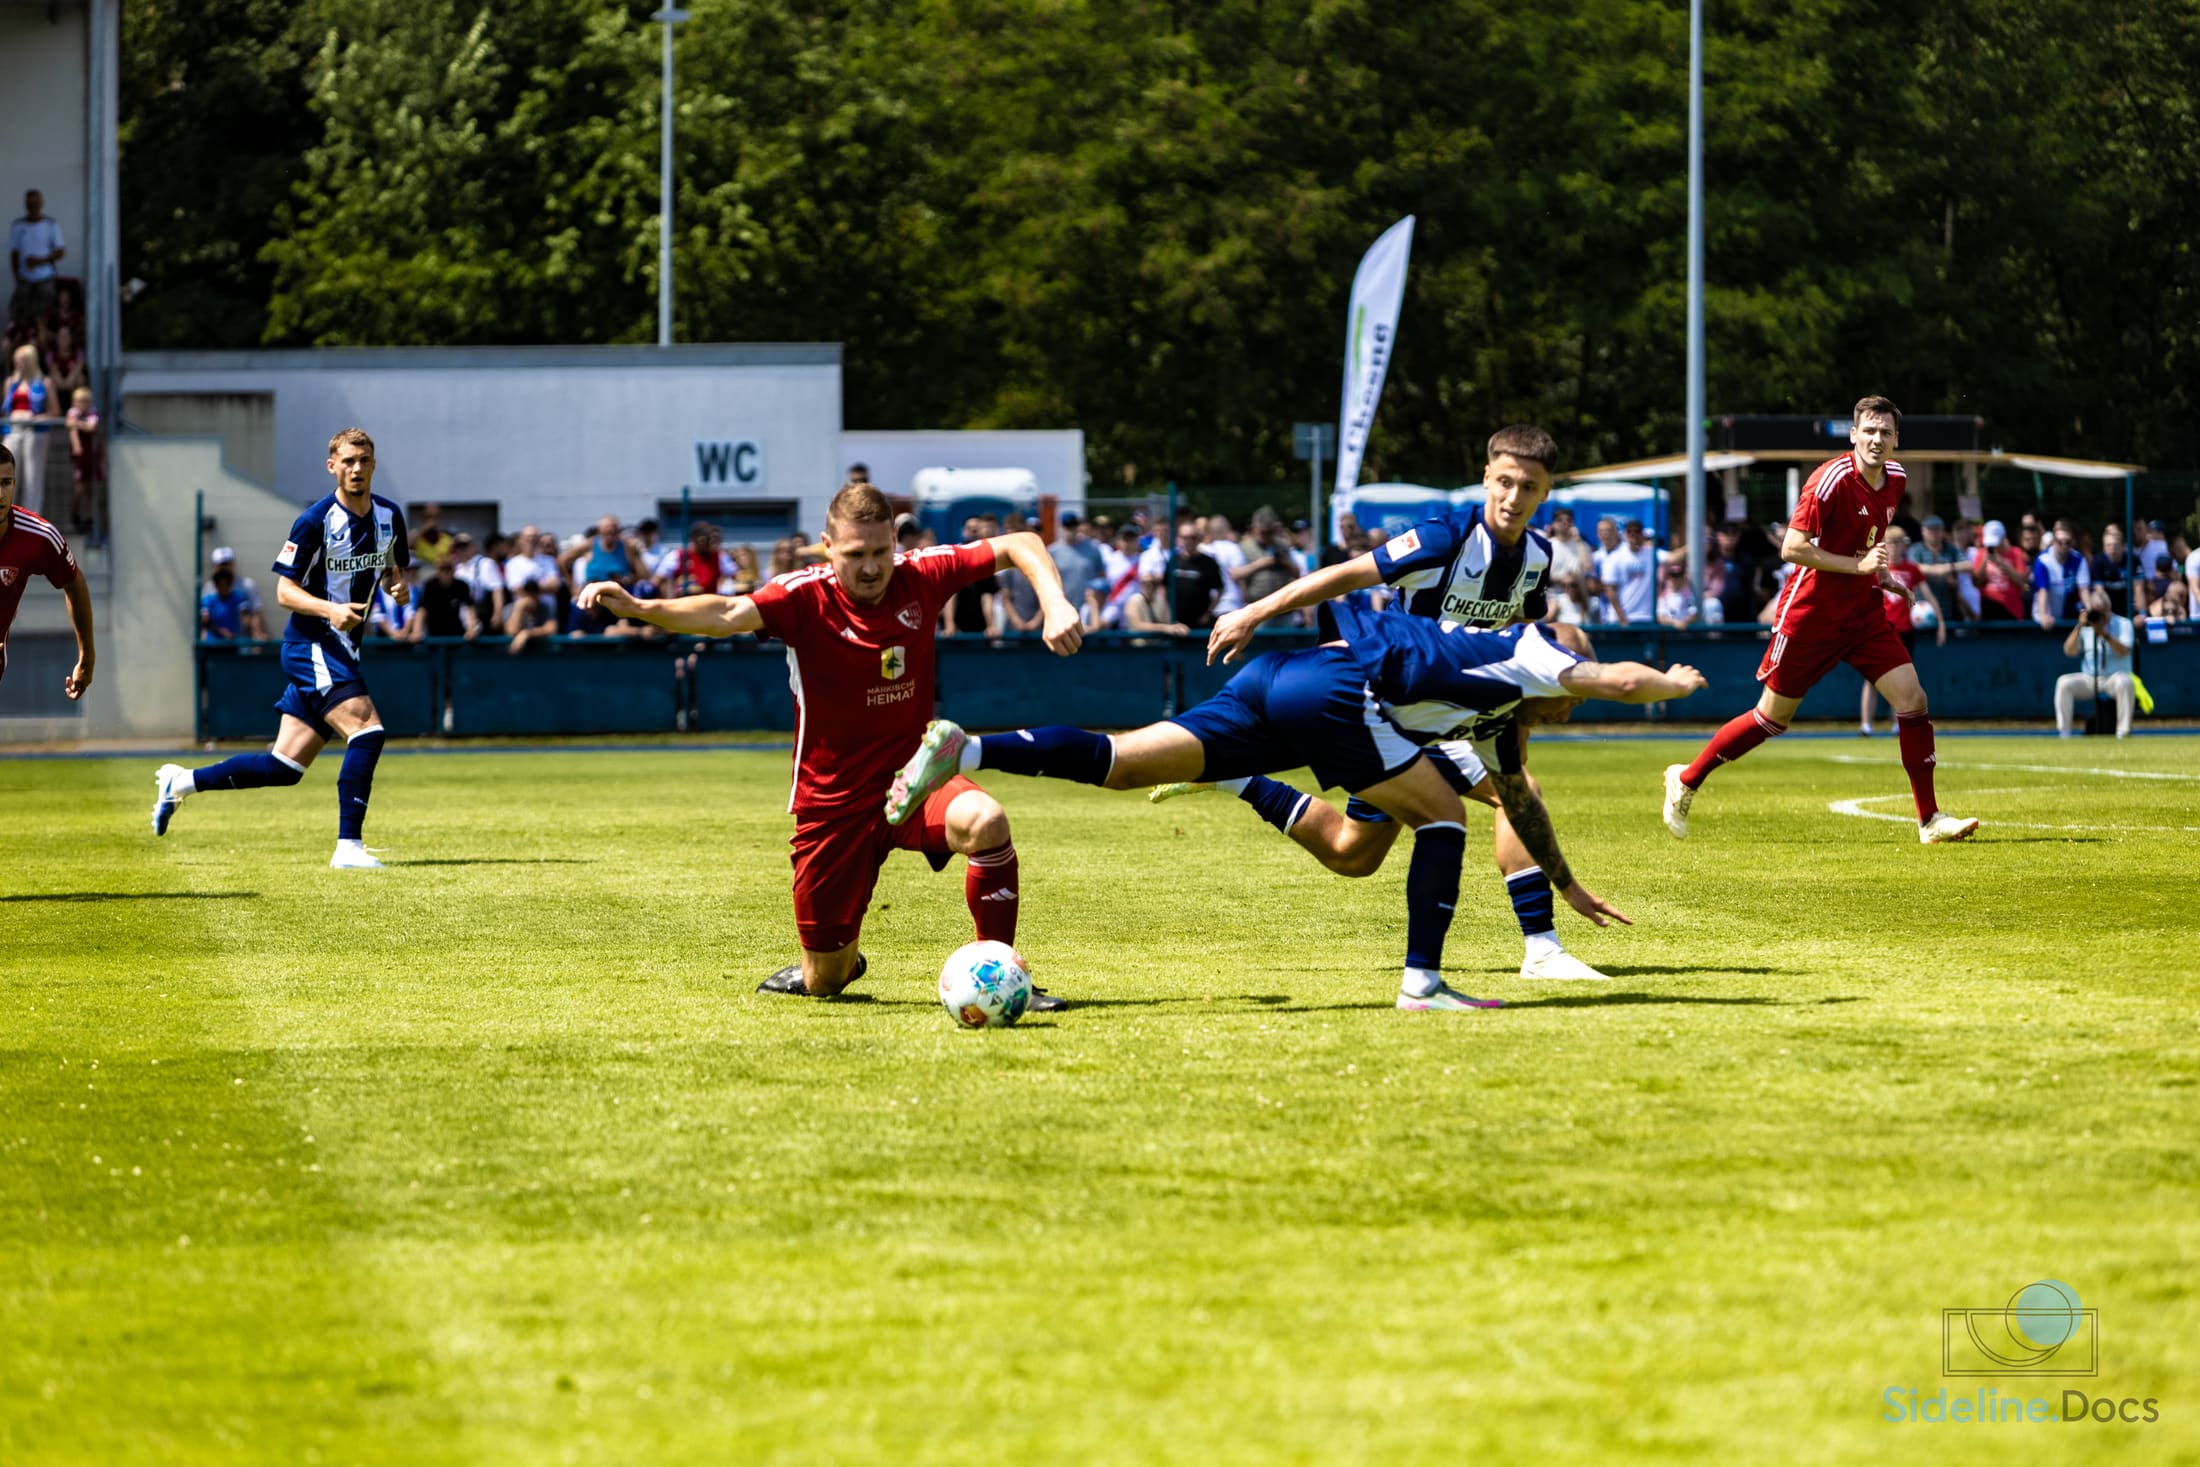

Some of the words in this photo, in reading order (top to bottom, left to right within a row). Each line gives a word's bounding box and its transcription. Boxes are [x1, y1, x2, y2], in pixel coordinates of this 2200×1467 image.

[696, 441, 757, 482] WC
[1444, 594, 1520, 619] CHECKCARS
[867, 687, 916, 707] HEIMAT
